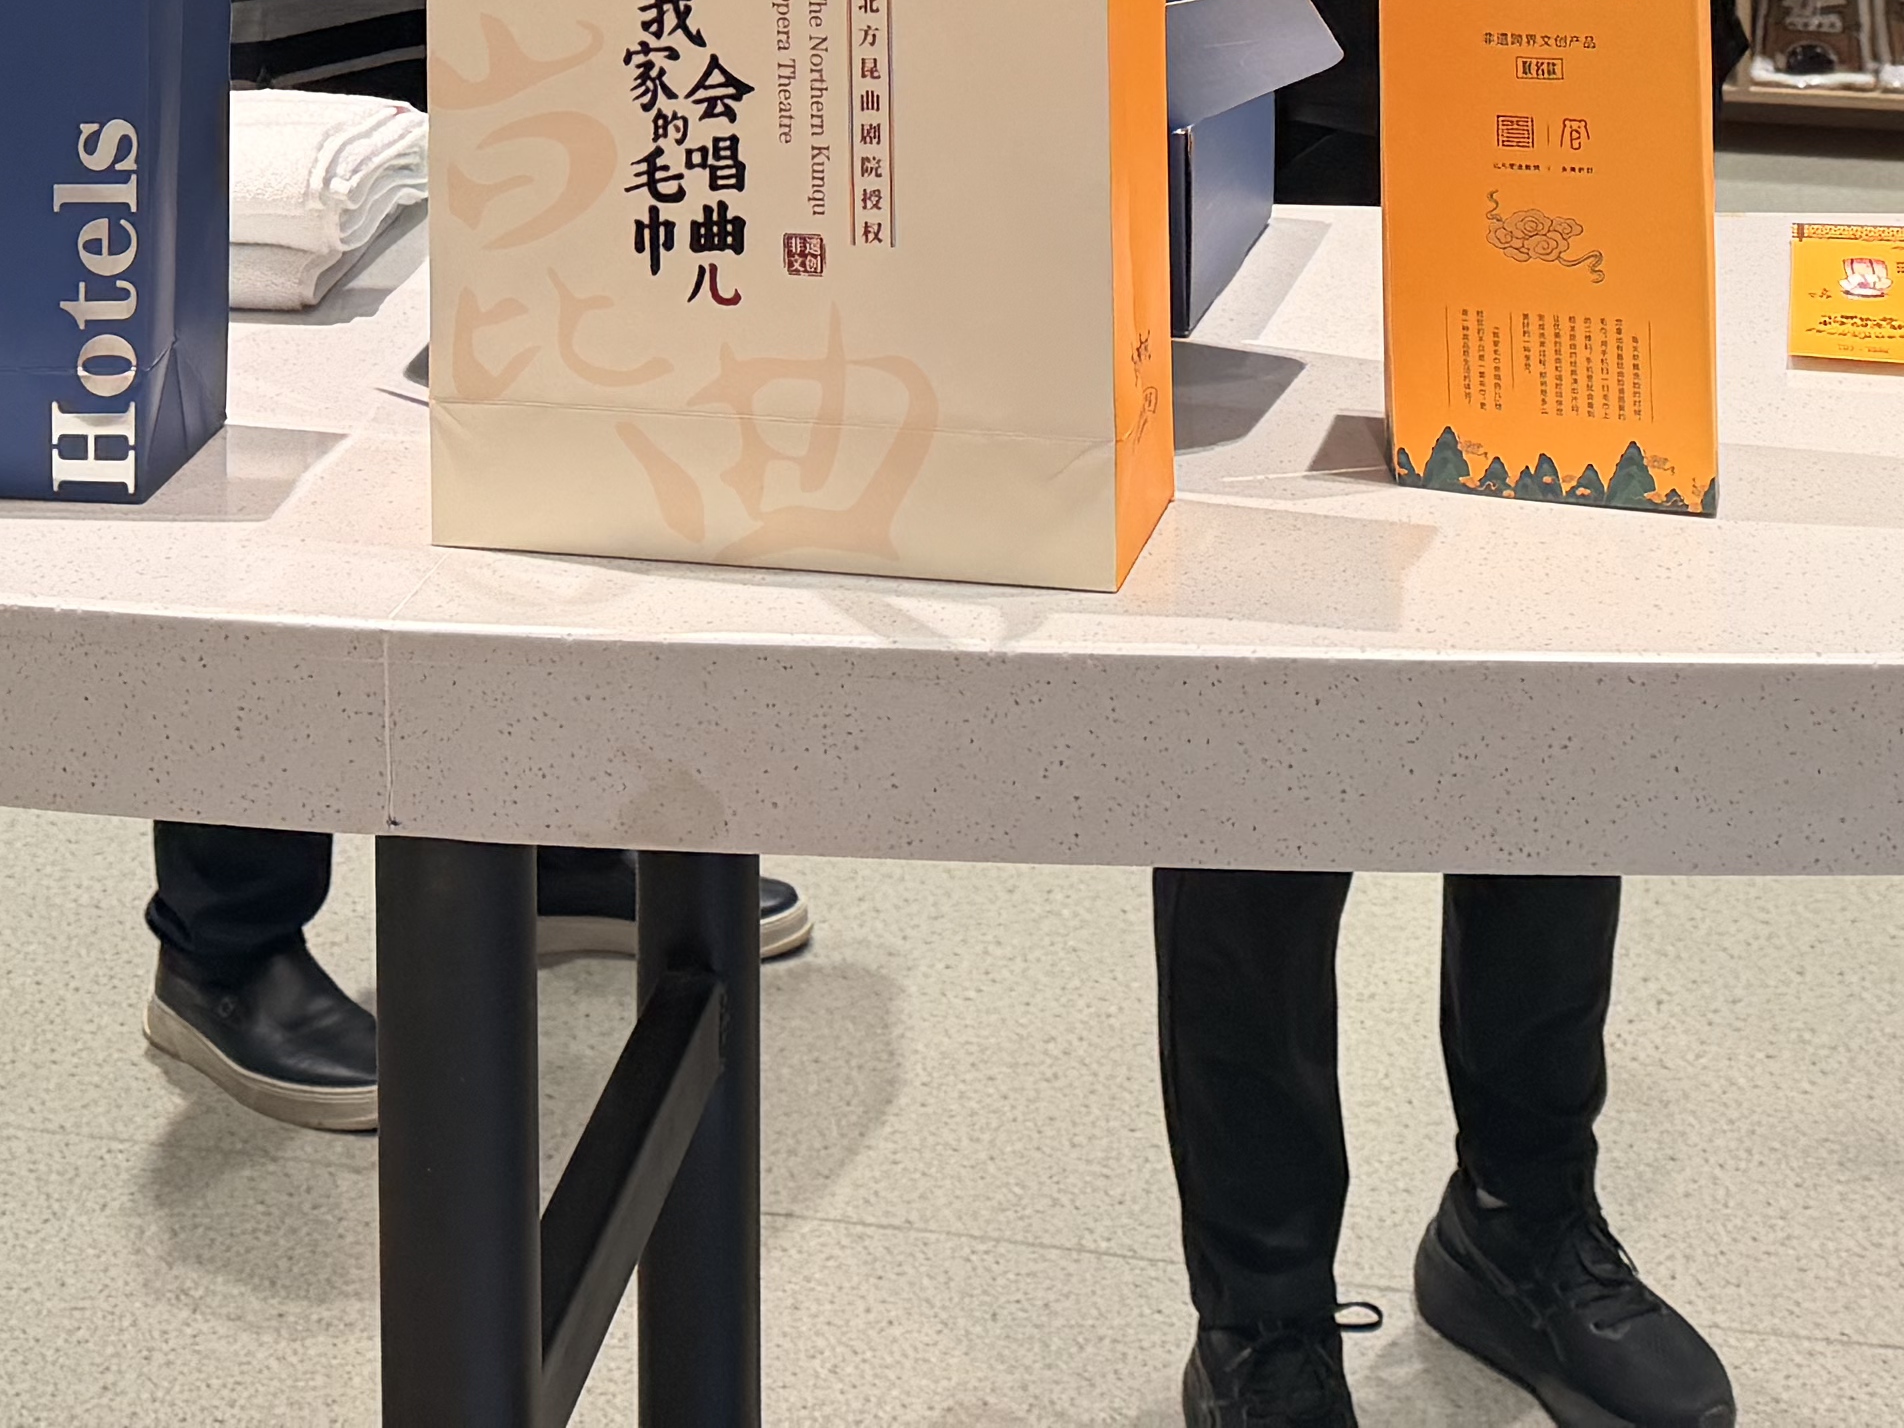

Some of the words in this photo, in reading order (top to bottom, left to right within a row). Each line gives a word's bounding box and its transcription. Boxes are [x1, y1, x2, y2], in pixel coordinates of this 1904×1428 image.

[808, 34, 829, 137] Northern
[1483, 31, 1597, 50] 非遗跨界文创产品
[777, 58, 796, 145] Theatre
[683, 52, 756, 307] 会唱曲儿
[807, 144, 831, 217] Kunqu
[50, 116, 142, 496] Hotels
